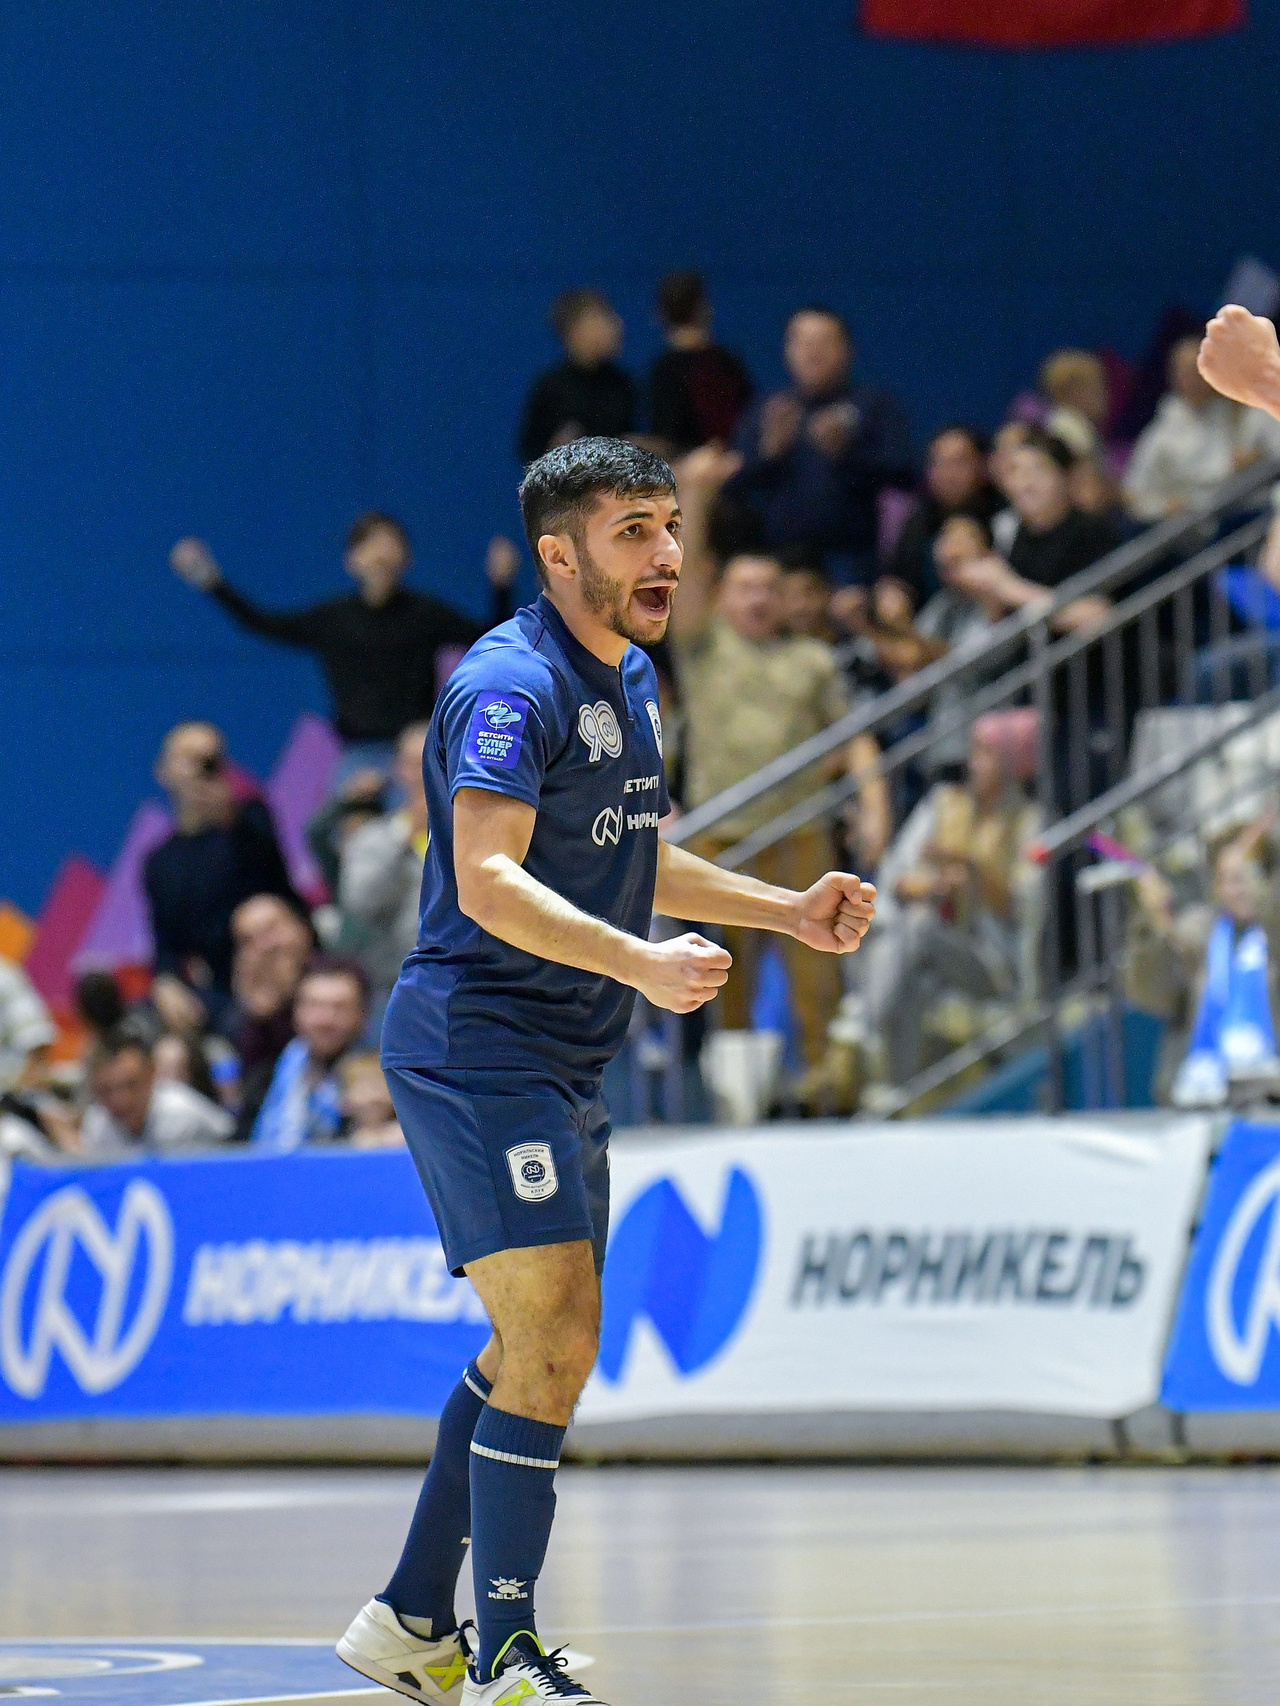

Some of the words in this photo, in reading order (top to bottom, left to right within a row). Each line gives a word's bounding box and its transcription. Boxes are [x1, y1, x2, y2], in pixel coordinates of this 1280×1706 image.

[478, 731, 514, 742] БЕТСИТИ
[476, 738, 513, 750] СУПЕР
[478, 746, 507, 757] ЛИГА
[789, 1227, 1148, 1309] НОРНИКЕЛЬ
[488, 1591, 528, 1601] KELME
